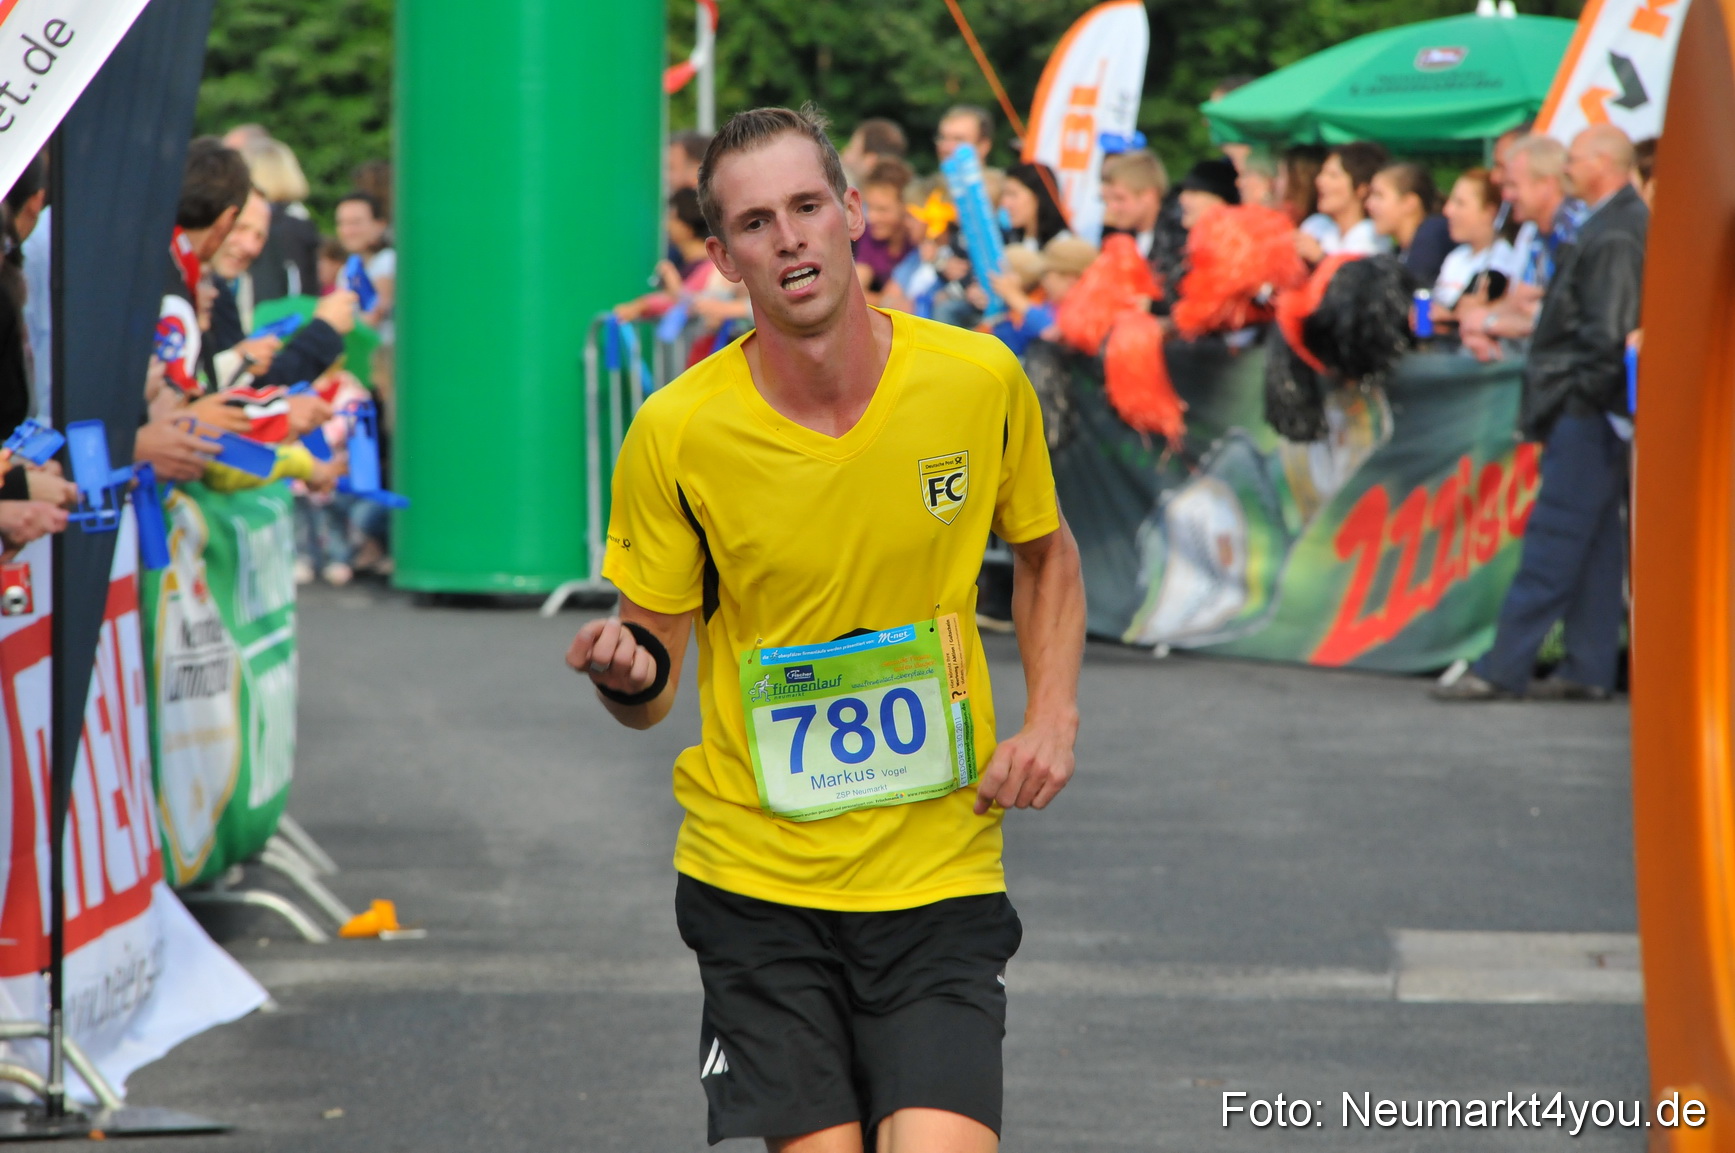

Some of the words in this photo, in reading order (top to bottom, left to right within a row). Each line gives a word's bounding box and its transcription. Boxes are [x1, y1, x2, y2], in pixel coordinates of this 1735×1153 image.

[925, 462, 945, 470] Deutsche
[928, 472, 964, 507] FC
[877, 631, 912, 644] M-net
[946, 619, 954, 643] Gutschein
[773, 674, 843, 695] firmenlauf
[787, 669, 812, 679] Fischer
[774, 692, 805, 700] neumarkt
[771, 687, 927, 775] 780
[954, 716, 963, 749] 3.10.2011
[810, 768, 876, 791] Markus
[881, 766, 908, 778] Vogel
[958, 752, 967, 785] ETSDORF
[836, 790, 851, 800] ZSP
[852, 784, 888, 797] Neumarkt
